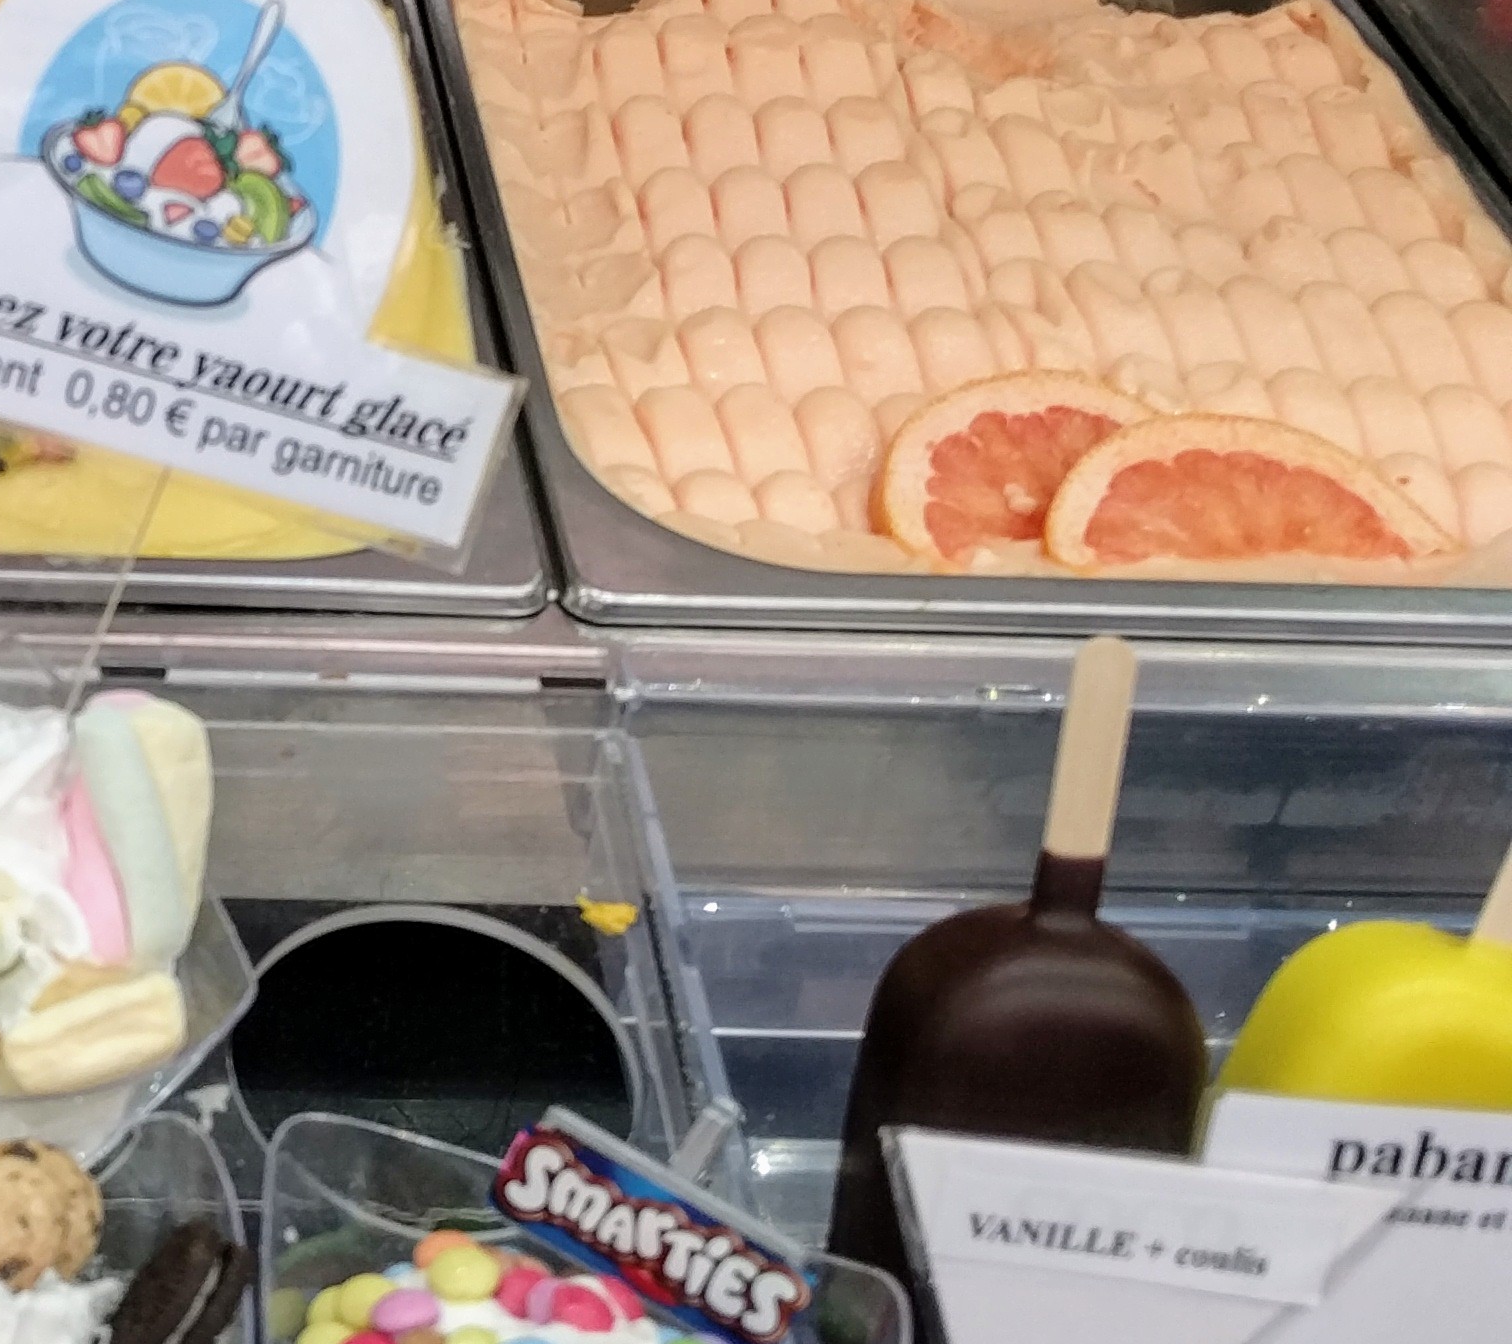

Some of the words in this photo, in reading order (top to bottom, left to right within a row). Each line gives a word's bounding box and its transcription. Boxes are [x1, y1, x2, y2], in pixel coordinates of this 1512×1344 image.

[58, 309, 182, 374] votre
[175, 351, 348, 419] yaourt
[340, 393, 476, 453] glacé
[63, 368, 158, 427] 0,80
[164, 396, 197, 438] €
[196, 413, 271, 456] par
[270, 437, 444, 506] garniture
[968, 1211, 1137, 1258] VANILLE
